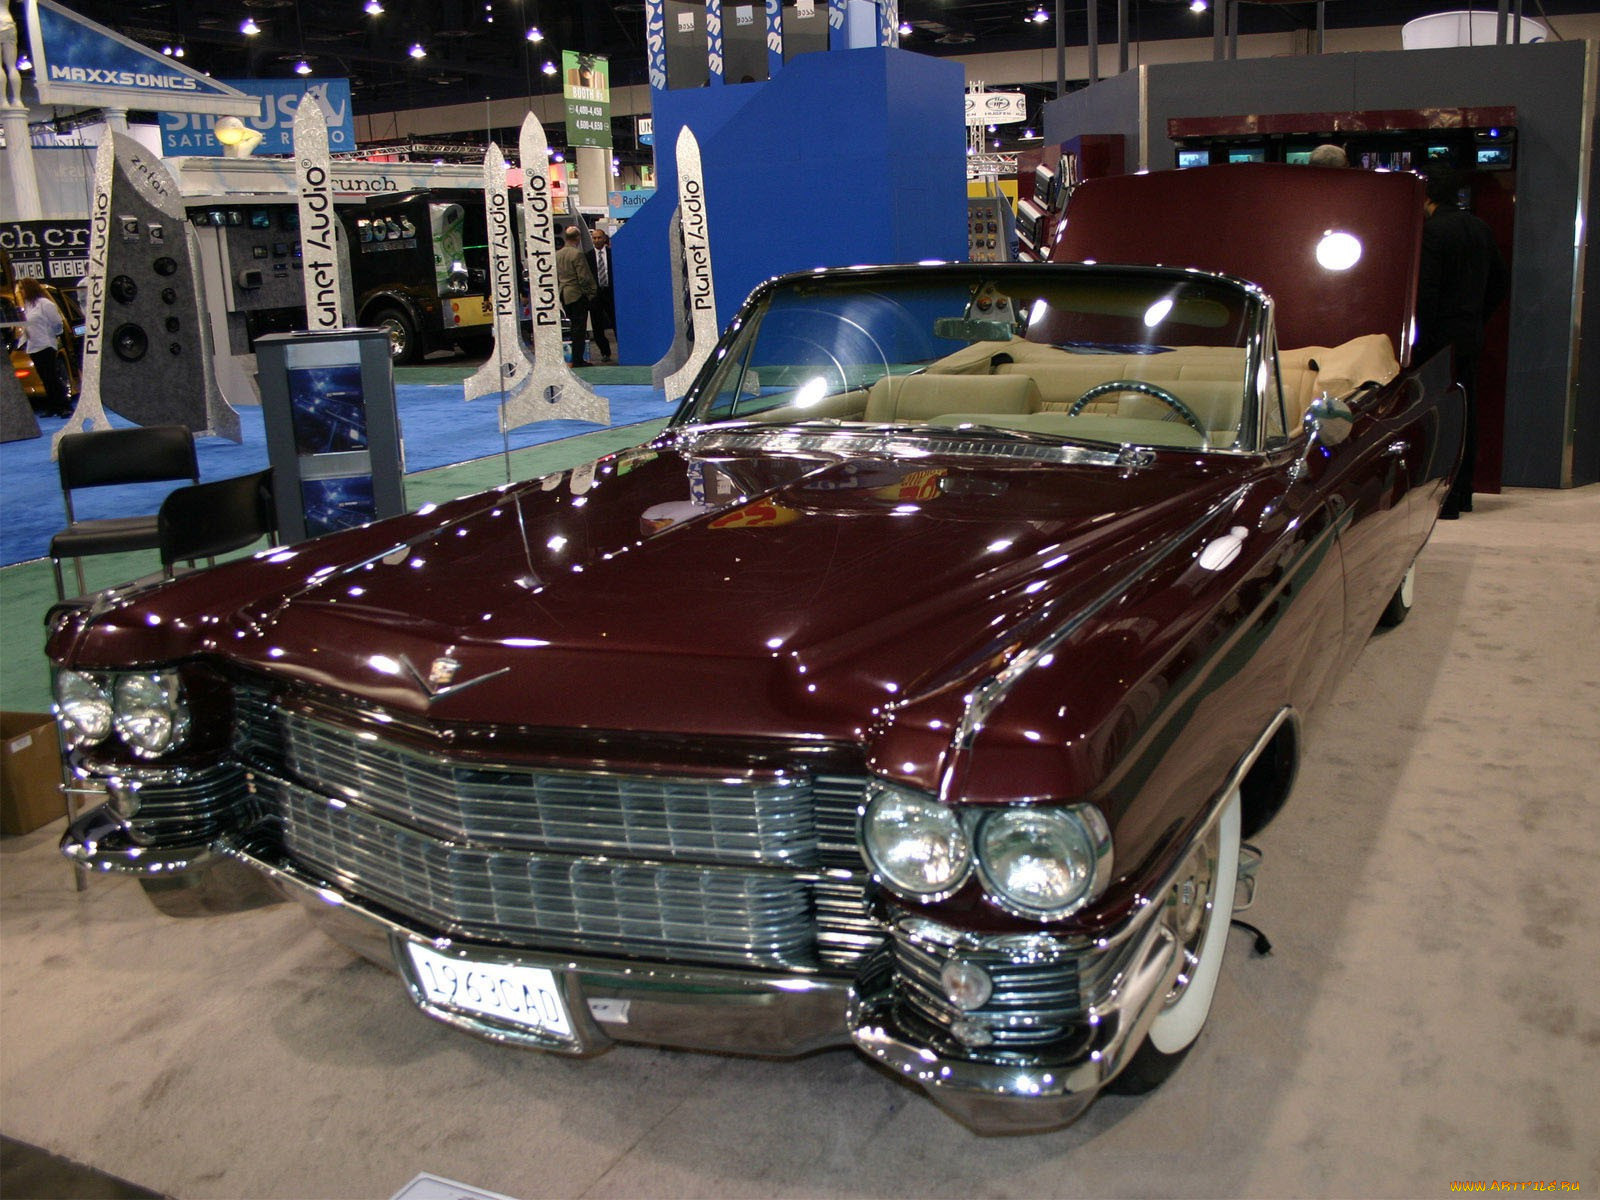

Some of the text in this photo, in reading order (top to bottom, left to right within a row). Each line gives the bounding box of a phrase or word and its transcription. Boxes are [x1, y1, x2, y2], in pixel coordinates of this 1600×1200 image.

[51, 65, 197, 90] MAXXSONICS
[302, 166, 332, 250] Audio
[331, 176, 399, 192] runch
[86, 192, 108, 354] Planet Audio
[489, 193, 512, 316] Planet Audio
[527, 175, 556, 326] Planet Audio
[684, 180, 712, 310] Planet Audio
[308, 261, 337, 328] anet
[424, 961, 559, 1024] 1963CAD
